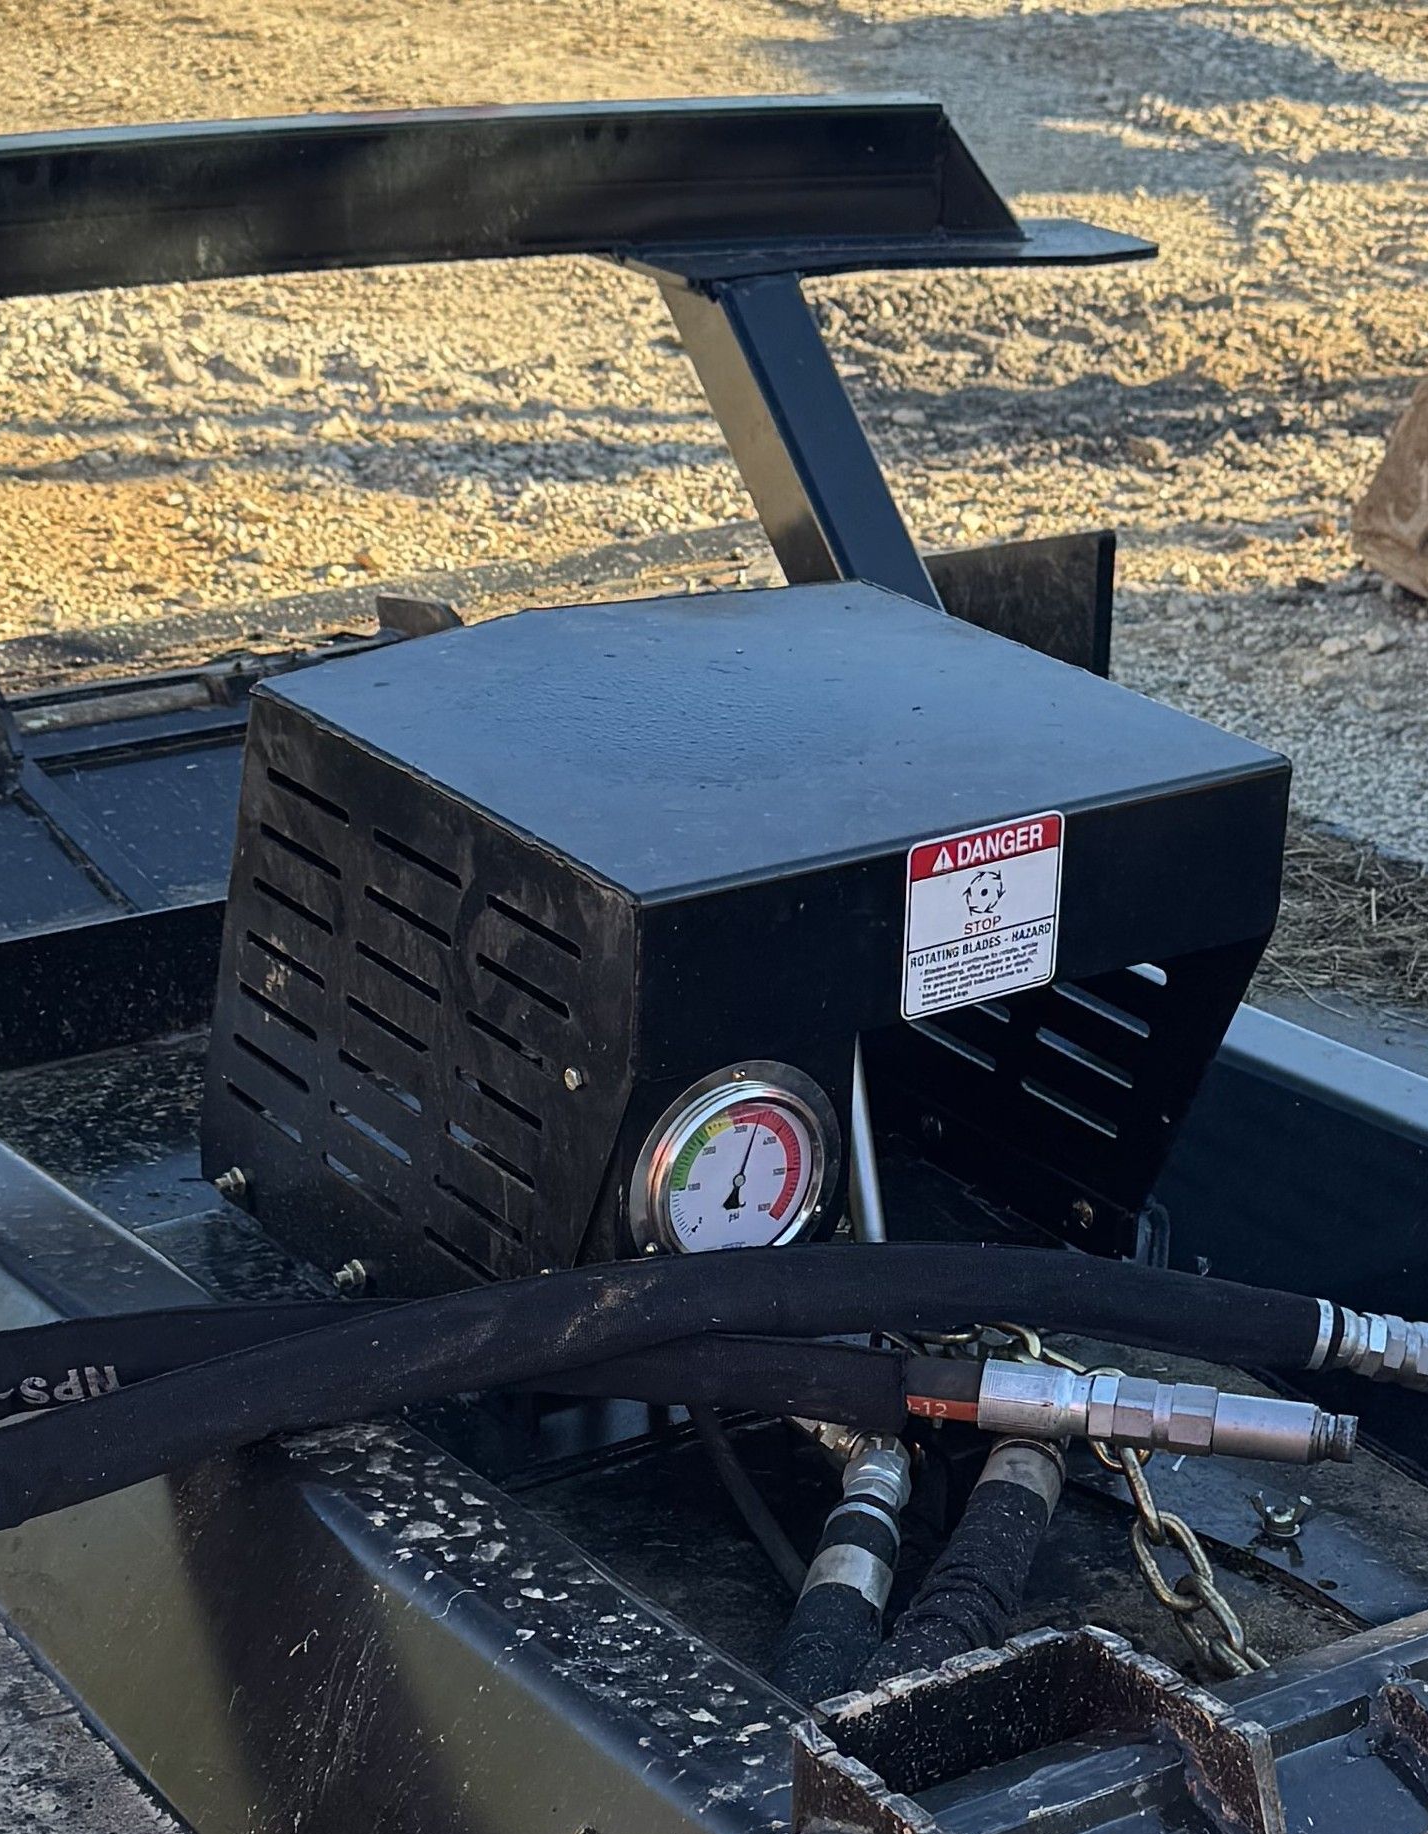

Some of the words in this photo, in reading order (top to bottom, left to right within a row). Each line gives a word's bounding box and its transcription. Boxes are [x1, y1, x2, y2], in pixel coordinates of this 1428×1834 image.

[957, 823, 1044, 867] DANGER
[910, 947, 959, 968] ROTATING
[962, 936, 1001, 955] BLADES
[1011, 922, 1051, 942] HAZARD
[964, 915, 1002, 935] STOP
